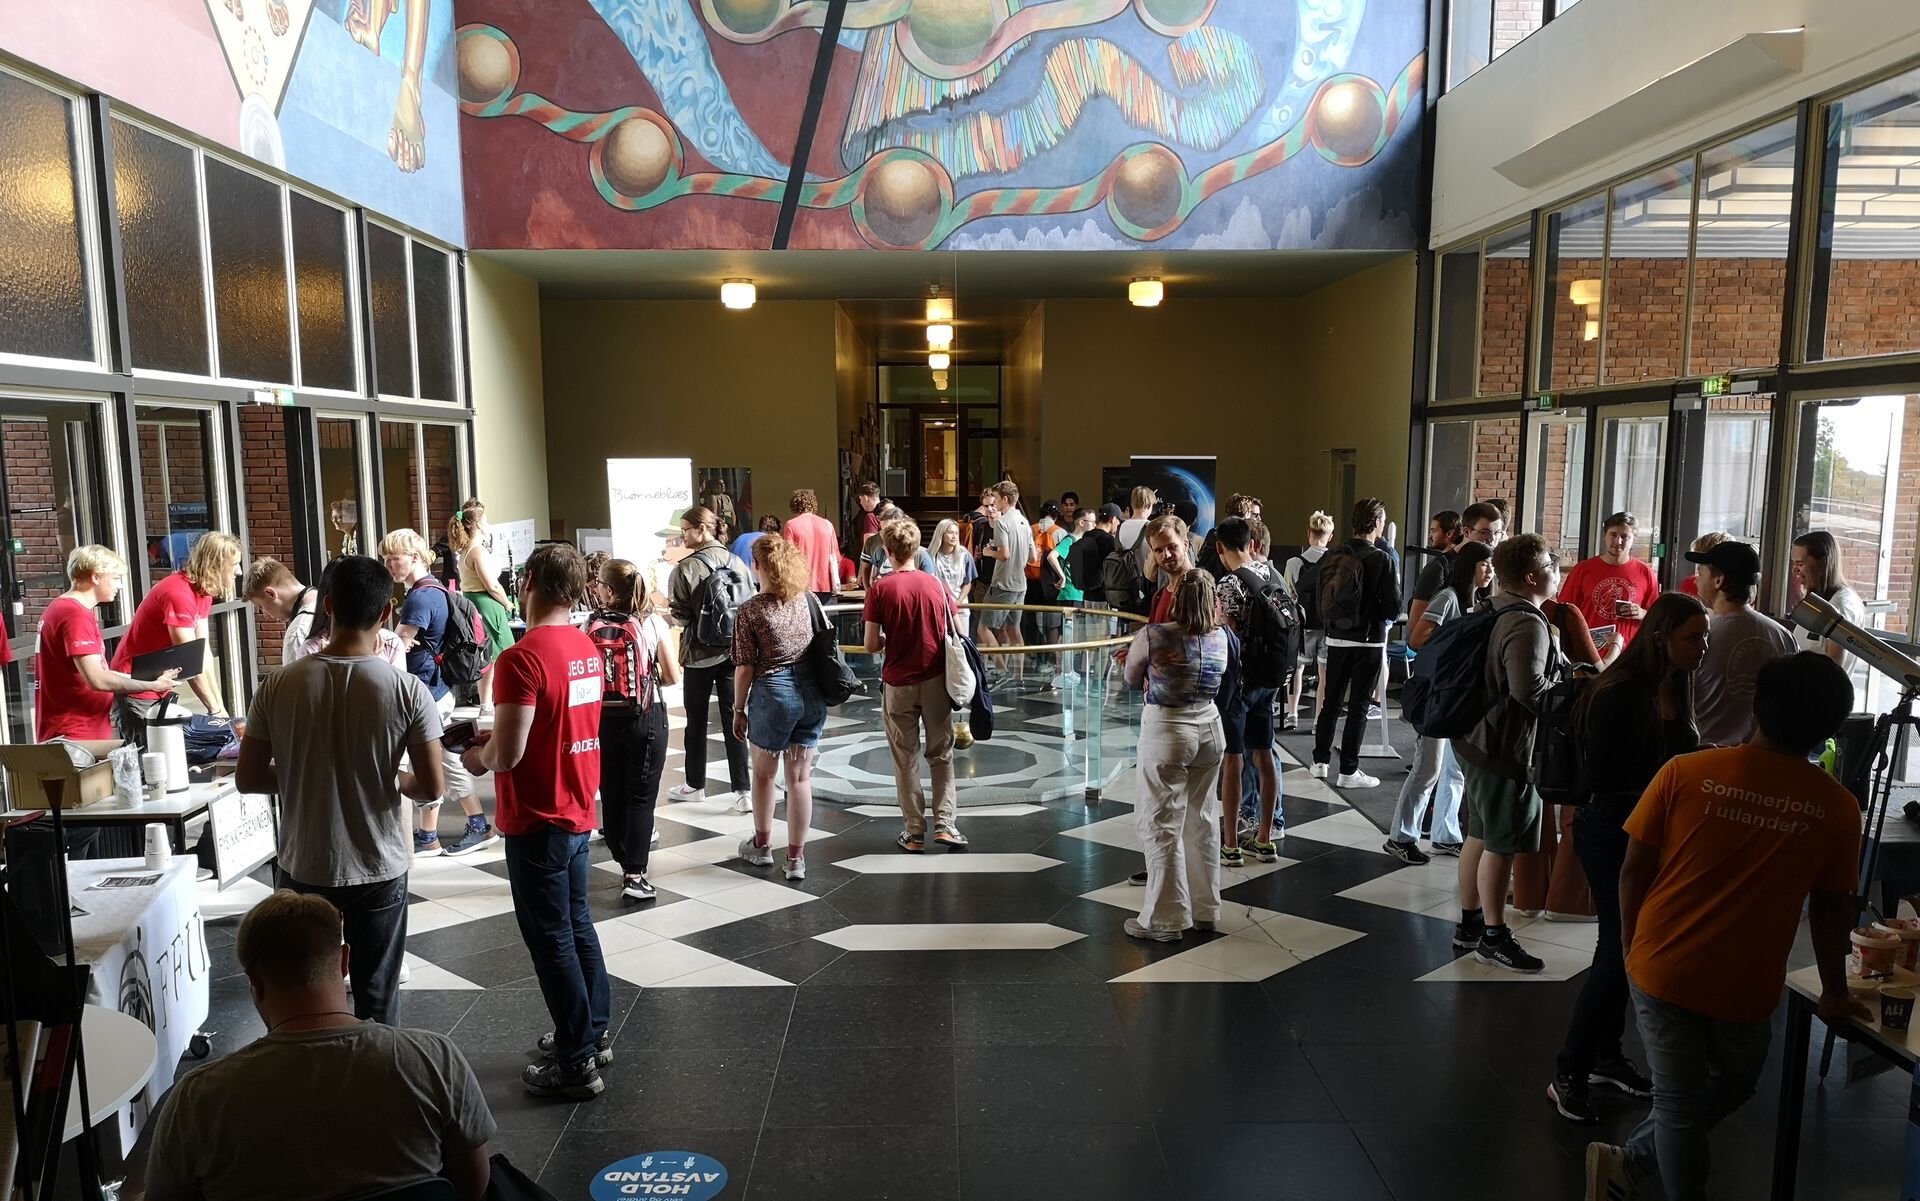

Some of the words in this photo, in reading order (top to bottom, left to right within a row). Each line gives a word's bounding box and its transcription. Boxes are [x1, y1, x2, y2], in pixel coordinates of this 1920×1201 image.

[587, 657, 600, 674] ER
[1701, 779, 1826, 820] Sommerjobb
[1704, 801, 1712, 815] i
[1716, 806, 1810, 836] utlandet?
[604, 1171, 720, 1183] AVSTAND
[621, 1184, 691, 1195] HOLD
